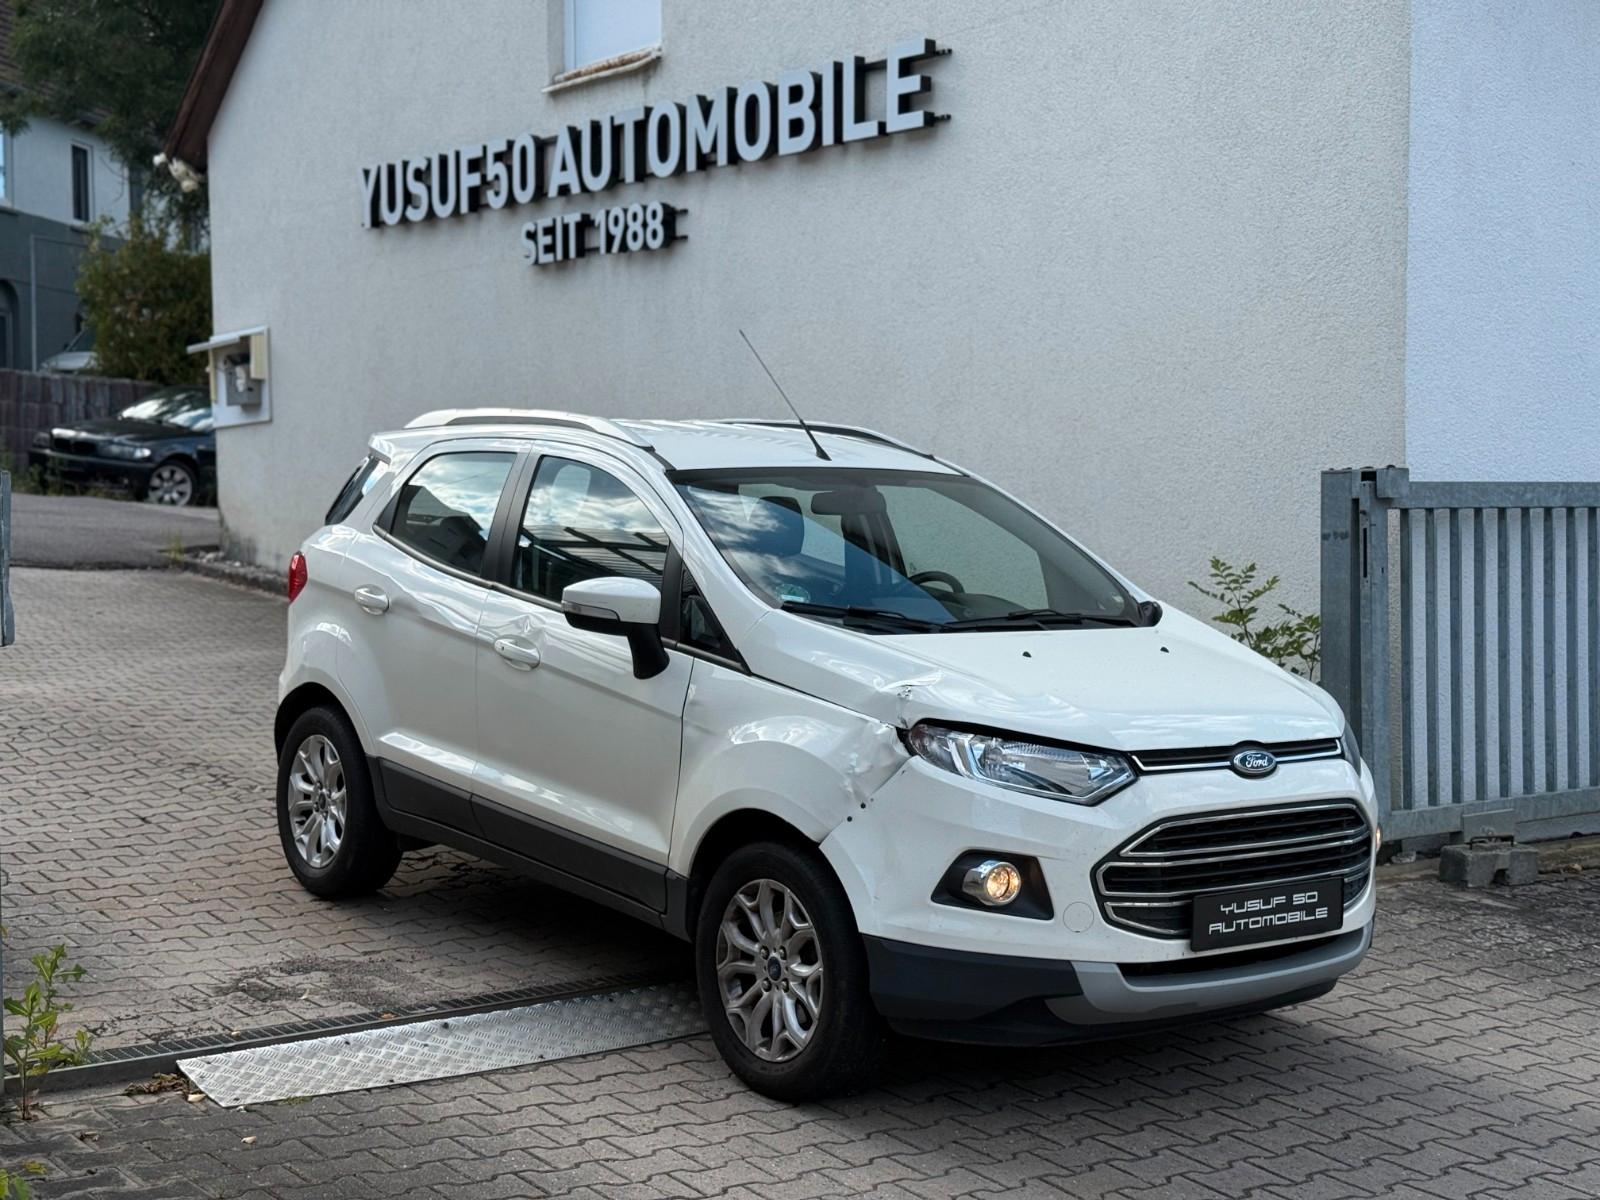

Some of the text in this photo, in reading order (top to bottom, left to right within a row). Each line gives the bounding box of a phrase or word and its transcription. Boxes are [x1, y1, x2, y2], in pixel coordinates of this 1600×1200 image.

[547, 39, 928, 198] AUTOMOBILE
[521, 201, 665, 265] SEIT 1988
[1245, 753, 1269, 768] Ford
[1220, 891, 1319, 916] YUSUF 50
[1208, 907, 1329, 935] AUTOMOBILE
